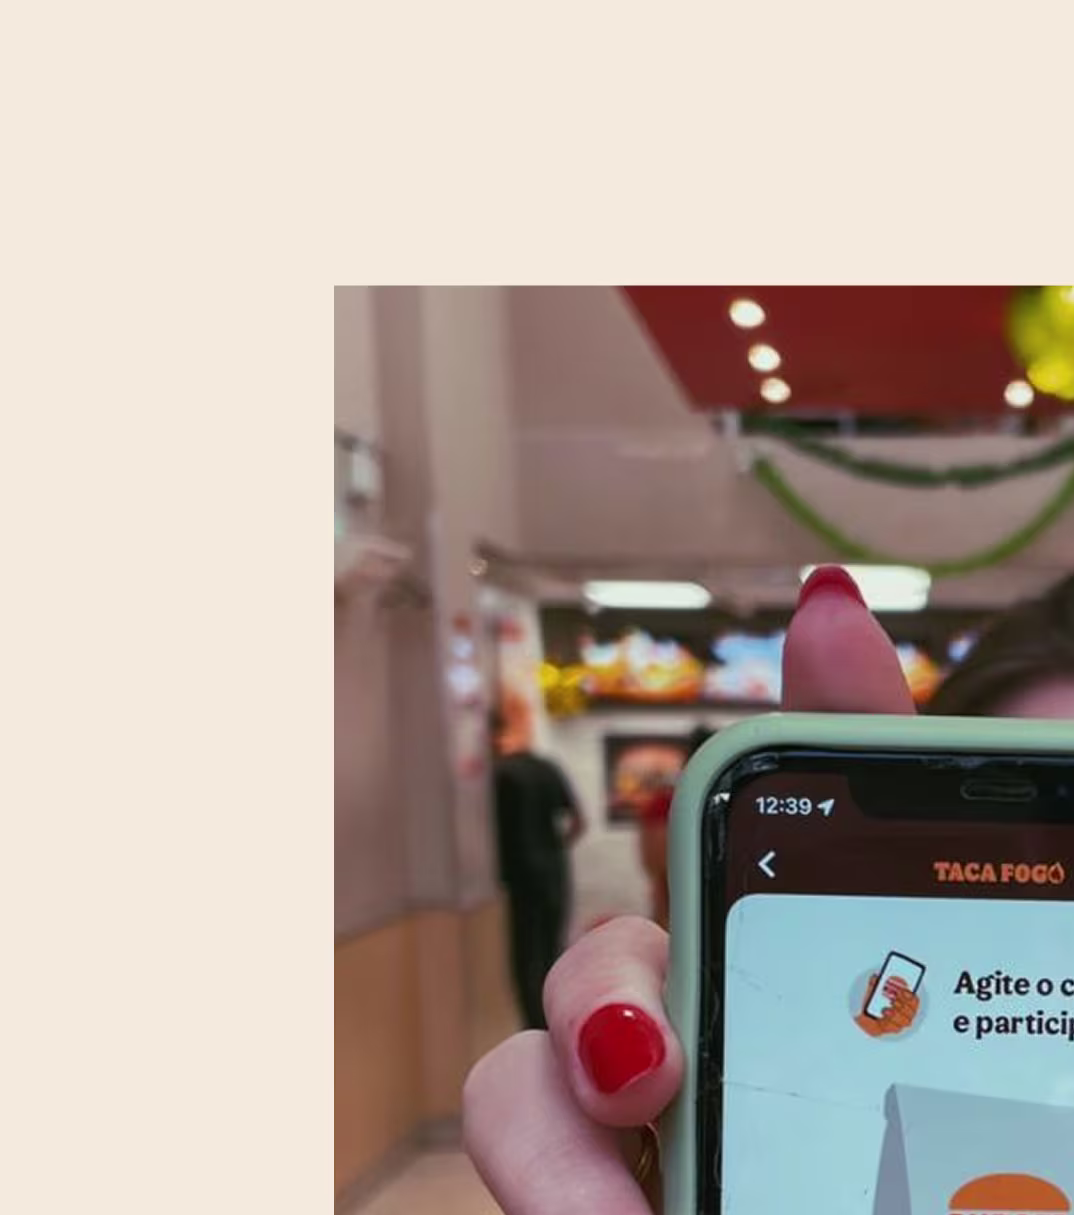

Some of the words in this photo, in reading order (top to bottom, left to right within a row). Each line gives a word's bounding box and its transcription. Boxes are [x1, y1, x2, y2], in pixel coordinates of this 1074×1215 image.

[755, 796, 812, 815] 12:39
[933, 860, 997, 883] TACA
[953, 970, 1031, 1000] Agite
[1036, 978, 1054, 997] o
[952, 1015, 971, 1034] e
